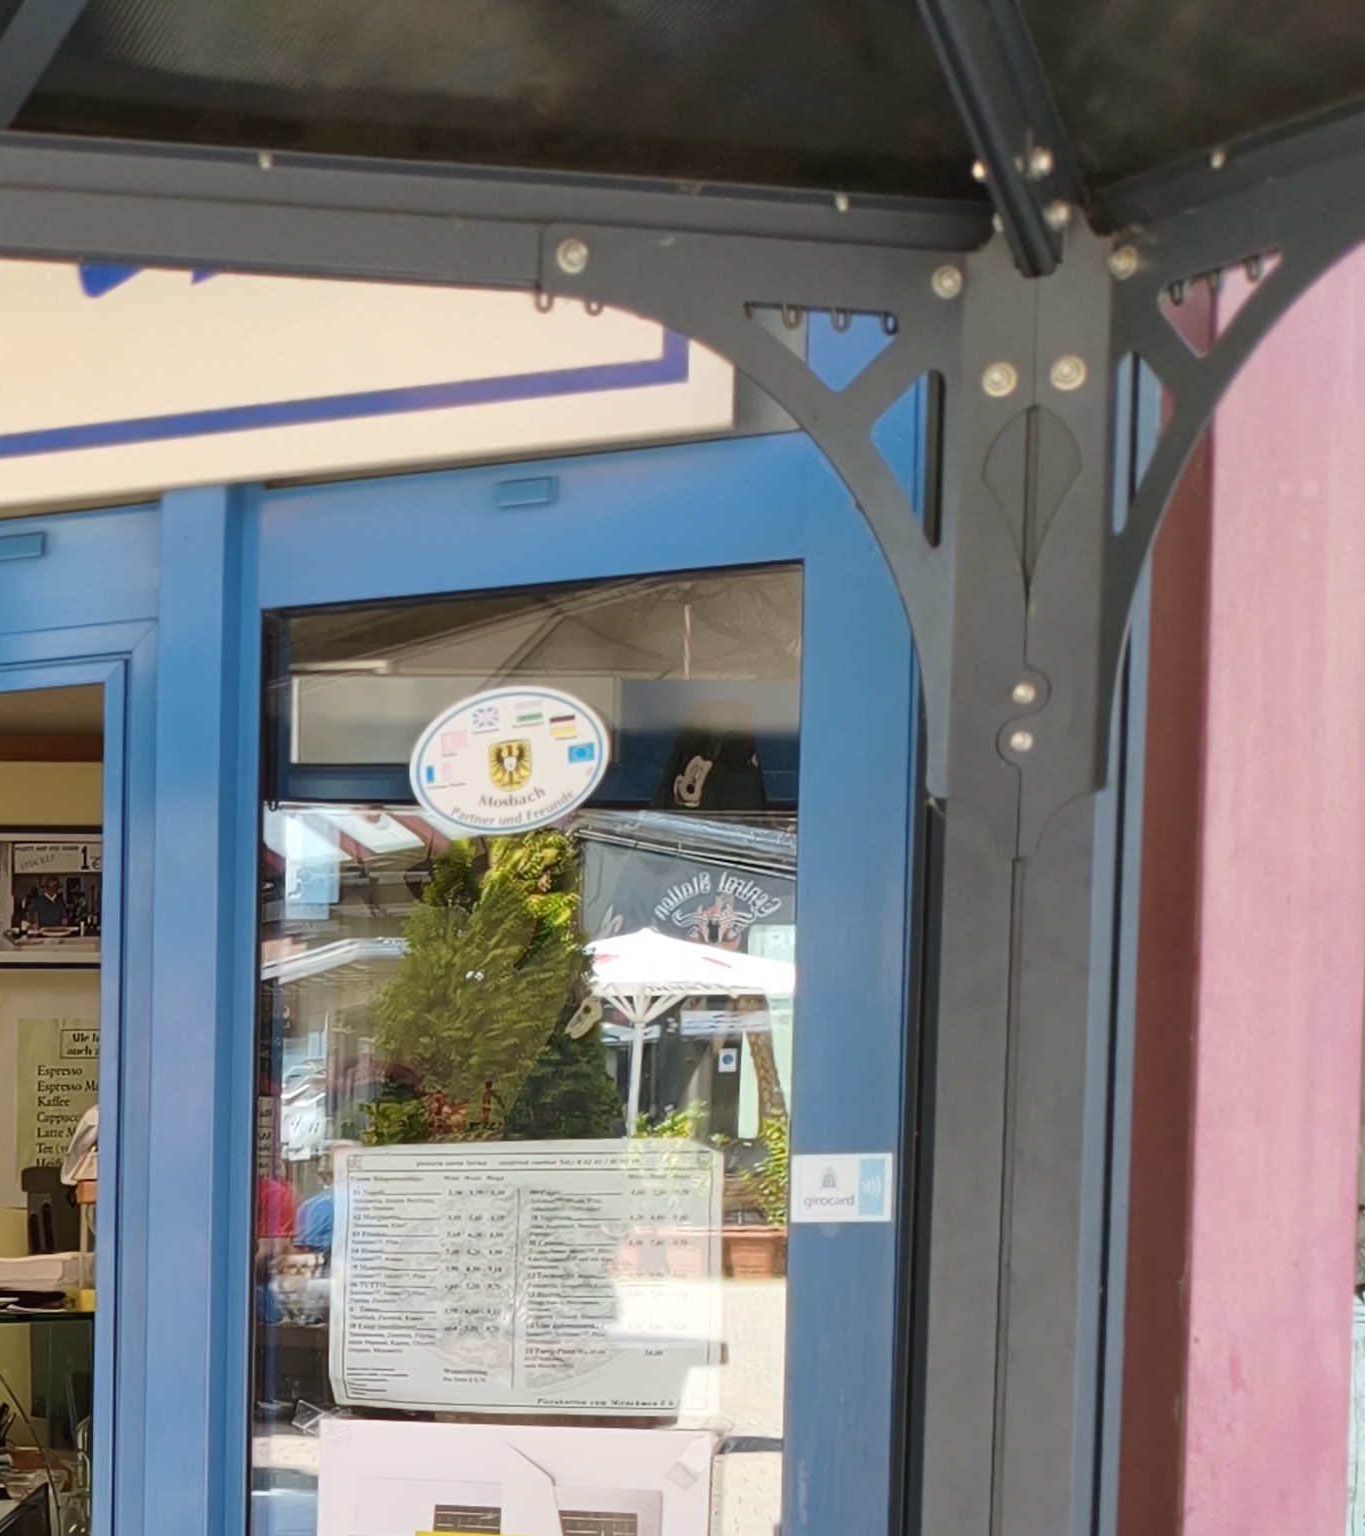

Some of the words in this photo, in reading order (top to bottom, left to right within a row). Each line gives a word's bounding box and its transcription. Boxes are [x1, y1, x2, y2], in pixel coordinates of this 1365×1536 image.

[478, 787, 546, 809] Mosbach
[450, 807, 495, 827] Partner
[498, 812, 522, 826] und
[526, 790, 575, 822] Freunde
[37, 1065, 83, 1079] Espresso
[37, 1081, 83, 1095] Espresso
[37, 1096, 71, 1107] Kaffee
[36, 1112, 81, 1126] Cappucc
[37, 1128, 64, 1138] Latte
[36, 1143, 53, 1153] Tee
[804, 1194, 856, 1209] girocard
